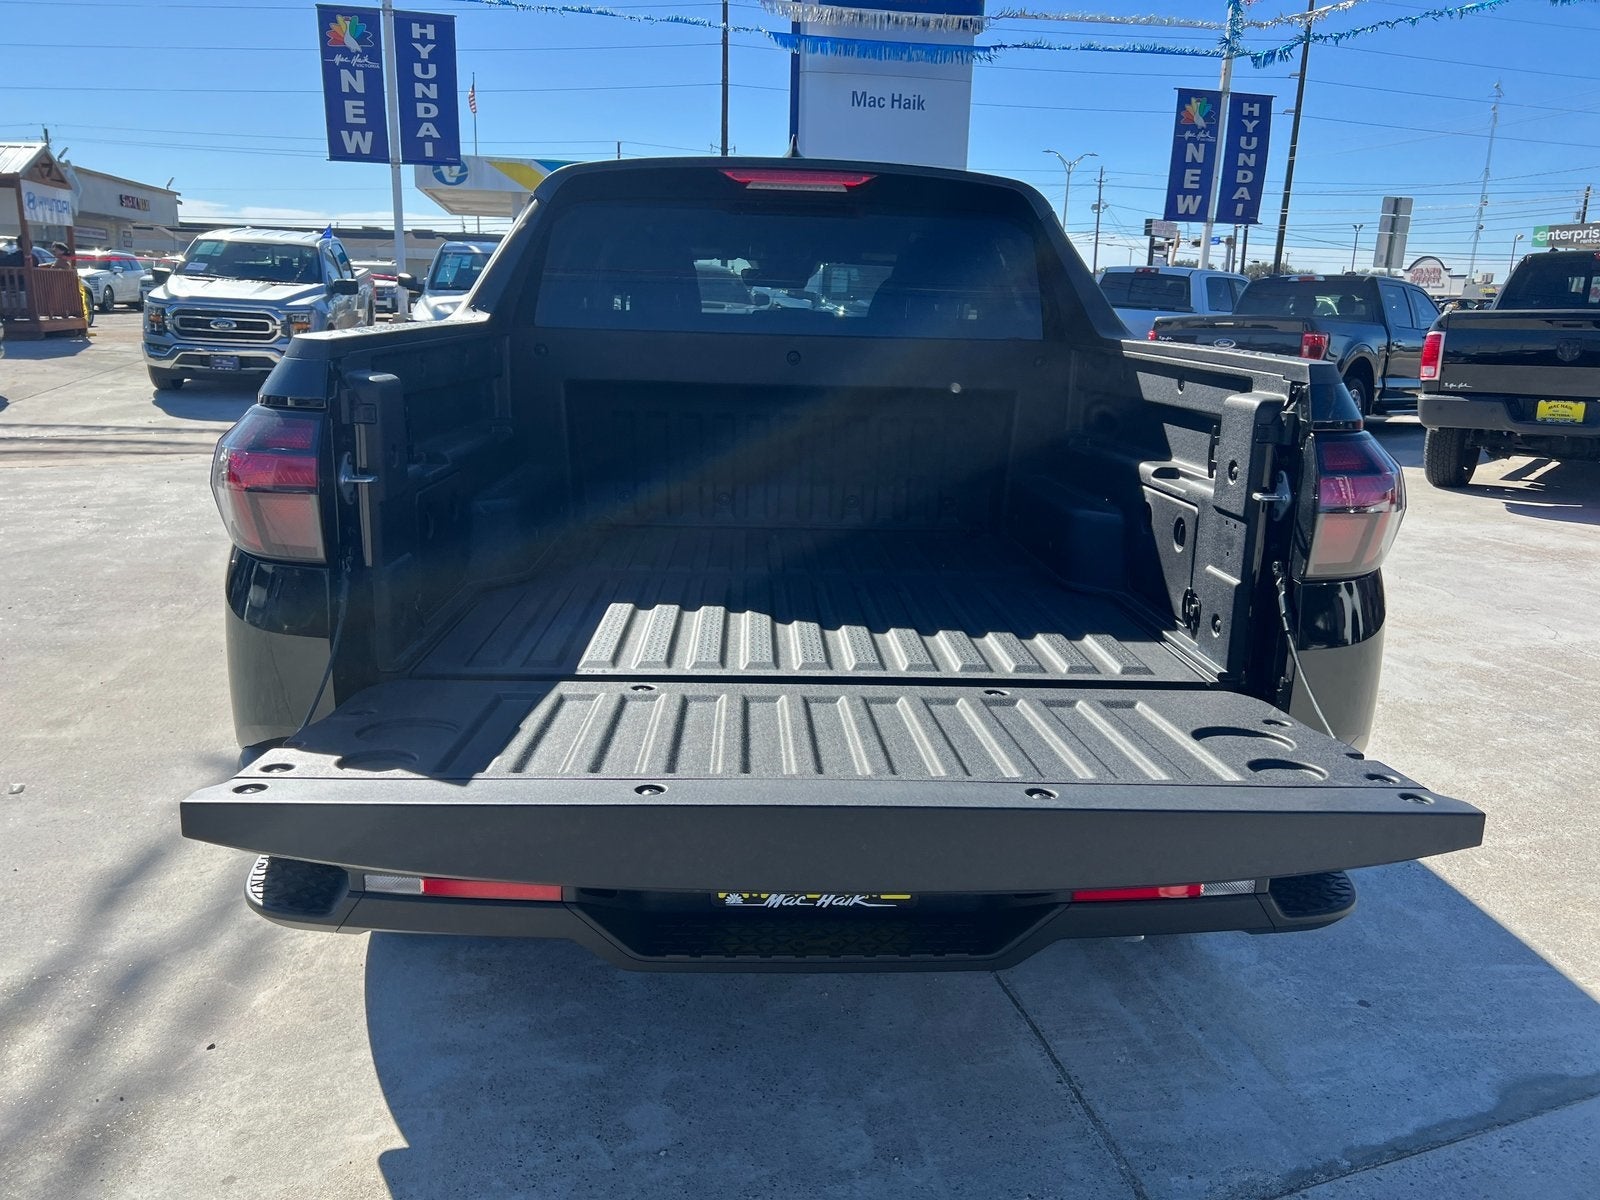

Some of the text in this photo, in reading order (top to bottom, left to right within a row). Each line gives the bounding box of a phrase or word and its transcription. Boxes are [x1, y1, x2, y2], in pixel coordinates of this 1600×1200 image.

[340, 69, 373, 154] NEW
[411, 23, 441, 157] HYUNDAI
[851, 90, 926, 111] Mac Haik
[1176, 142, 1206, 215] NEW
[1231, 102, 1260, 217] HYUNDAI
[762, 893, 808, 908] Mac
[815, 894, 873, 908] Haik
